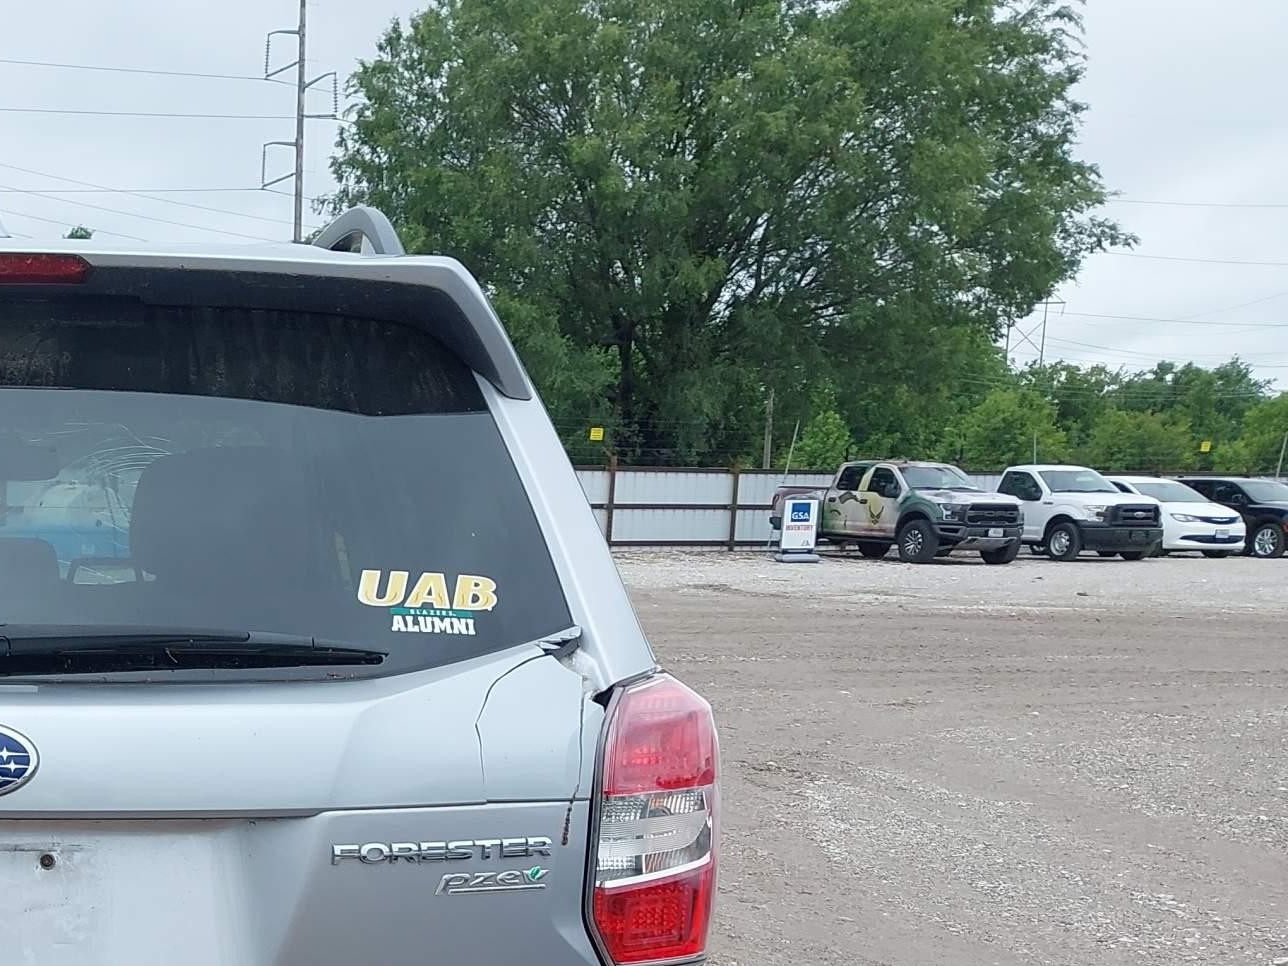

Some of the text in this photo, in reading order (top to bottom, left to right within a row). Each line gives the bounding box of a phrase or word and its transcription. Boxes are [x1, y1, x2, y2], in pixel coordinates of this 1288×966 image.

[792, 511, 810, 520] GSA
[358, 569, 498, 611] UAB
[392, 615, 476, 635] ALUMNI
[330, 835, 553, 866] FORESTER
